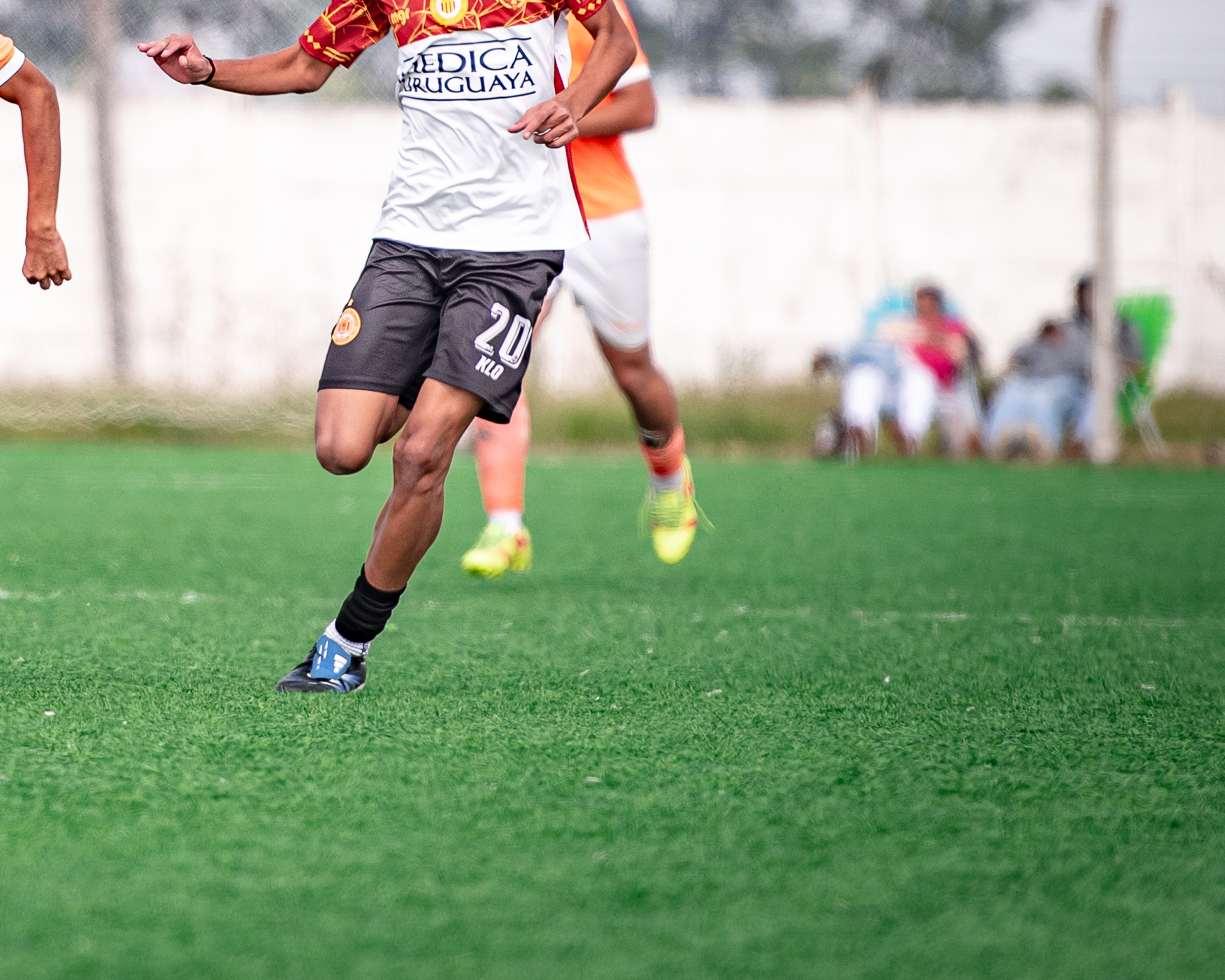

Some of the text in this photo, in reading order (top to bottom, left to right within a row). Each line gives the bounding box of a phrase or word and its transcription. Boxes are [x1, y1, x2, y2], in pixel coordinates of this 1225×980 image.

[411, 45, 533, 73] EDICA
[474, 301, 533, 369] 20
[474, 354, 505, 381] KLO
